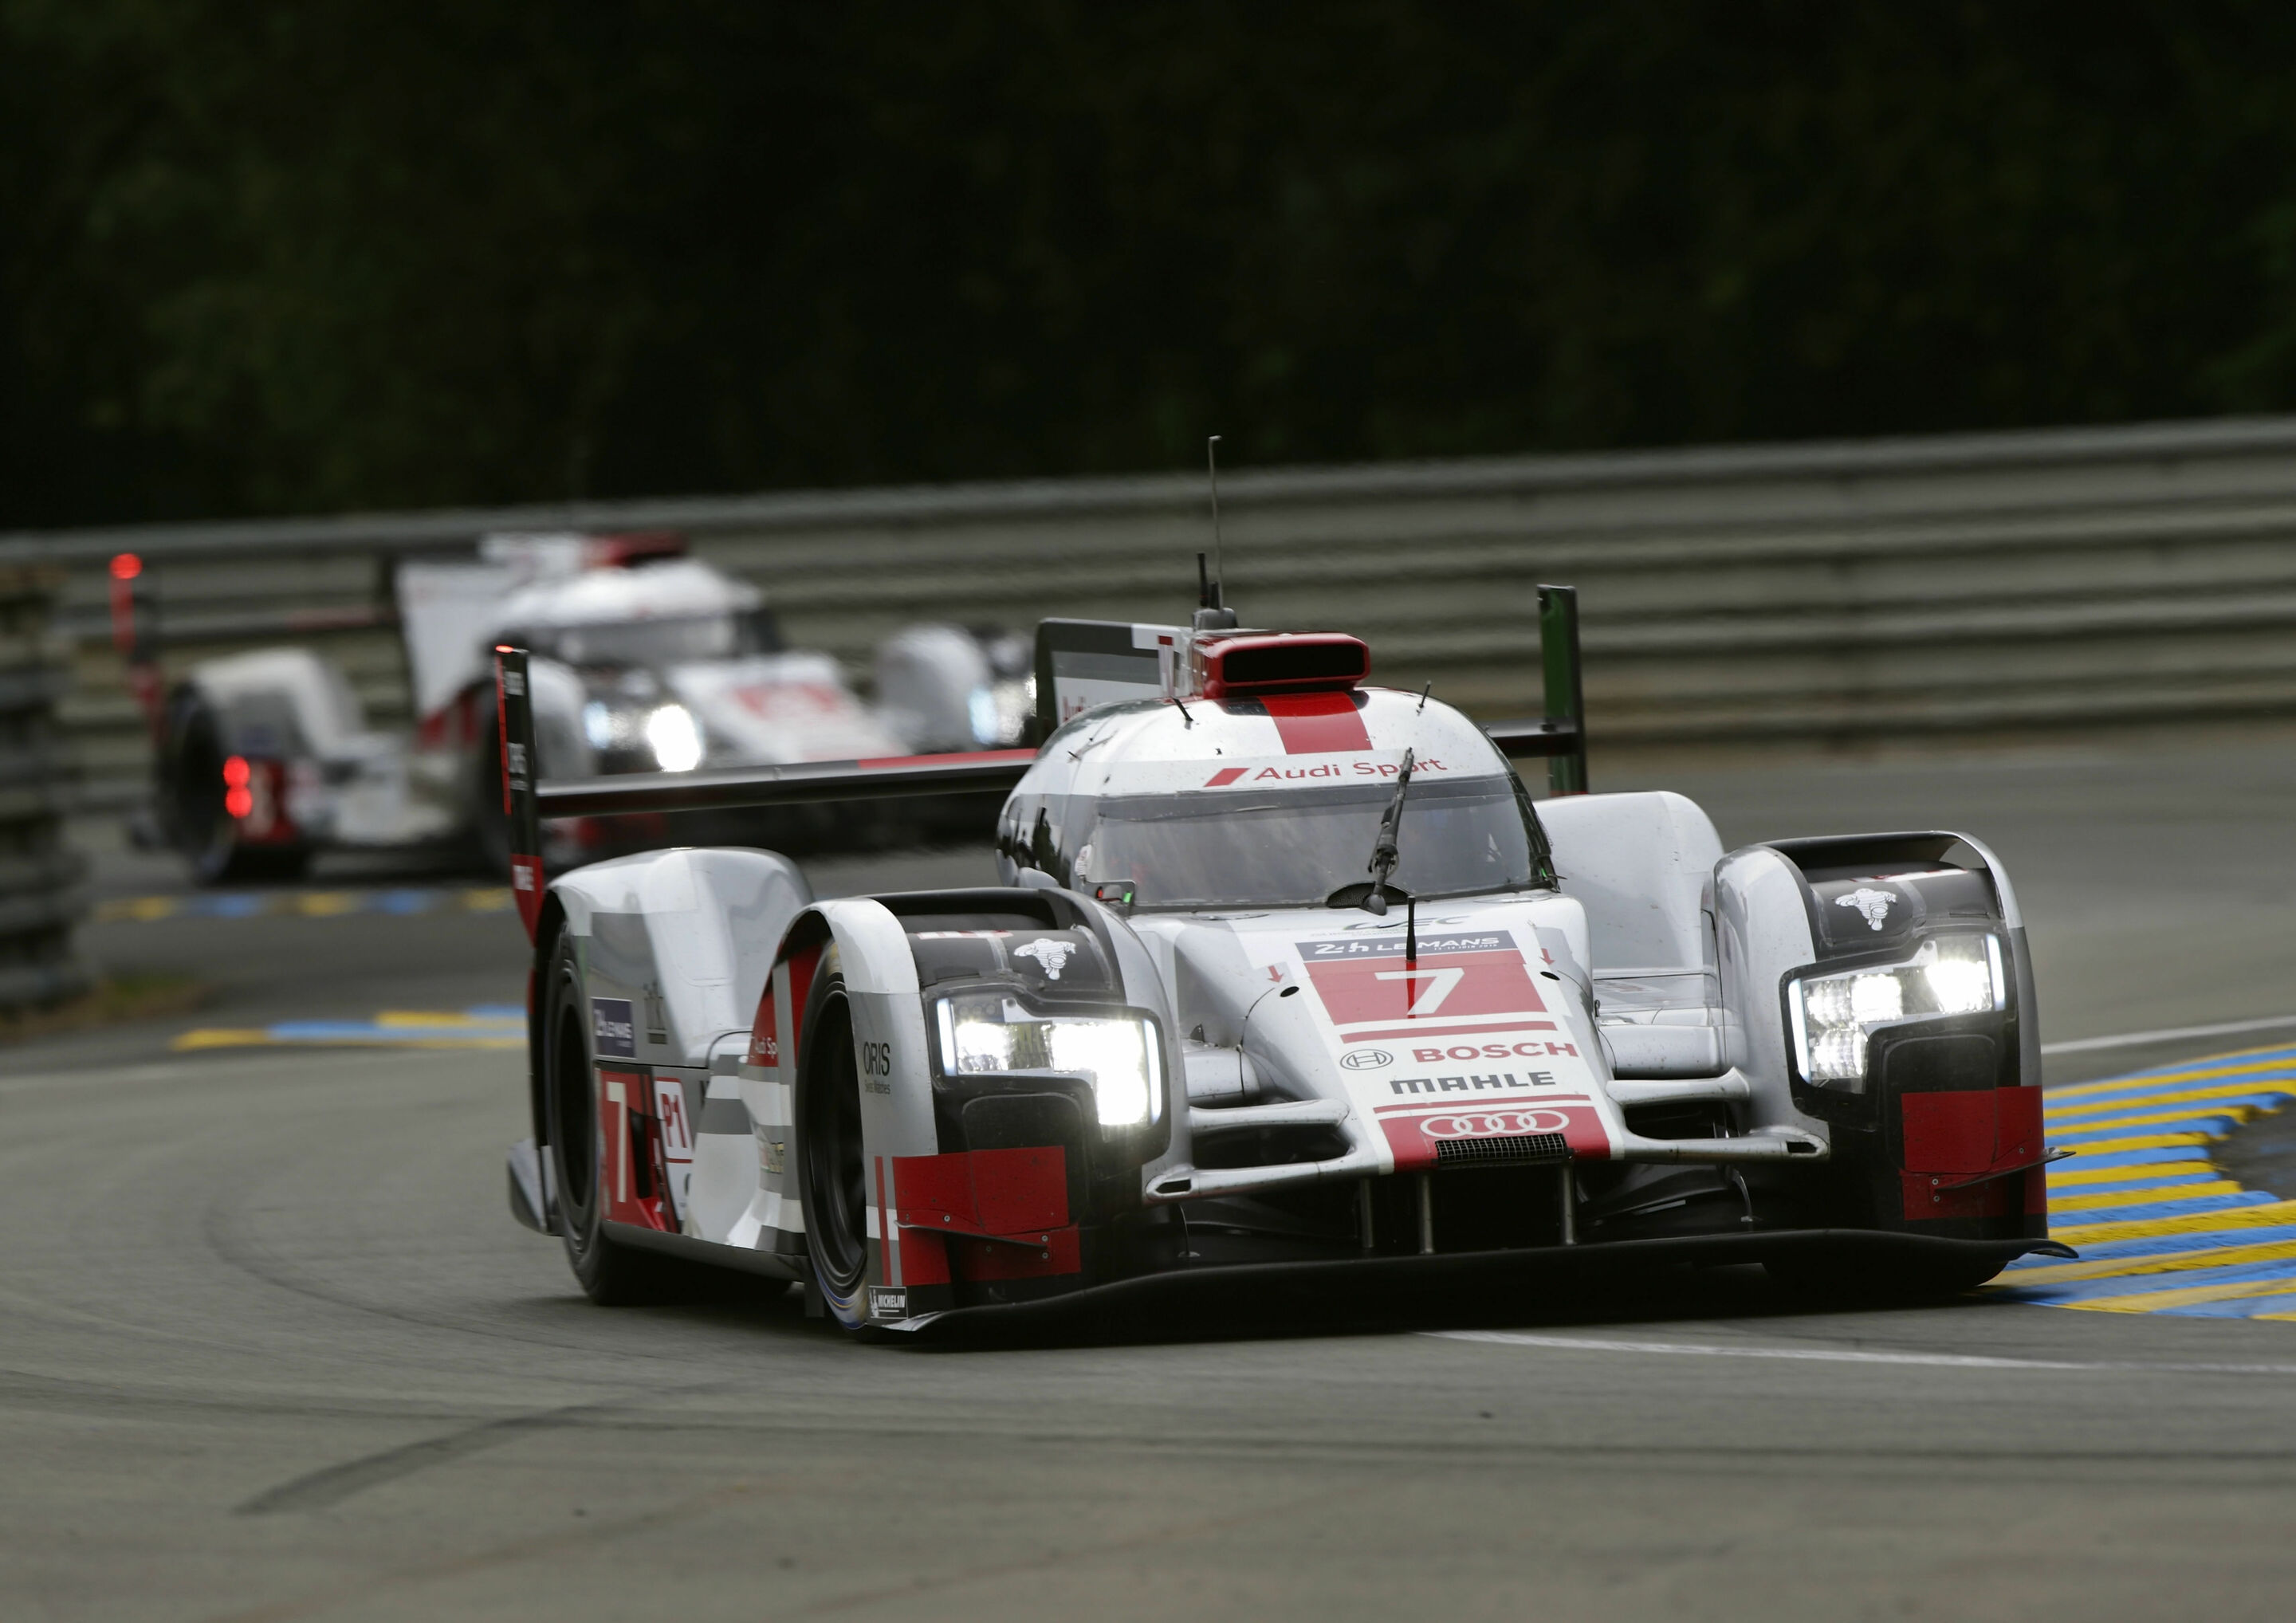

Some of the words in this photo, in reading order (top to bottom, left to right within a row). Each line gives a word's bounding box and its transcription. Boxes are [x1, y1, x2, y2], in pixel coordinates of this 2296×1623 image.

[1254, 764, 1341, 781] Audi
[1417, 937, 1500, 949] MANS
[1374, 967, 1464, 1016] 7
[863, 1041, 890, 1076] ORIS
[1412, 1042, 1579, 1063] BOSCH
[1390, 1071, 1556, 1095] MAHLE
[660, 1093, 687, 1148] P1
[606, 1081, 627, 1202] 7
[878, 1294, 906, 1308] MICHELIN
